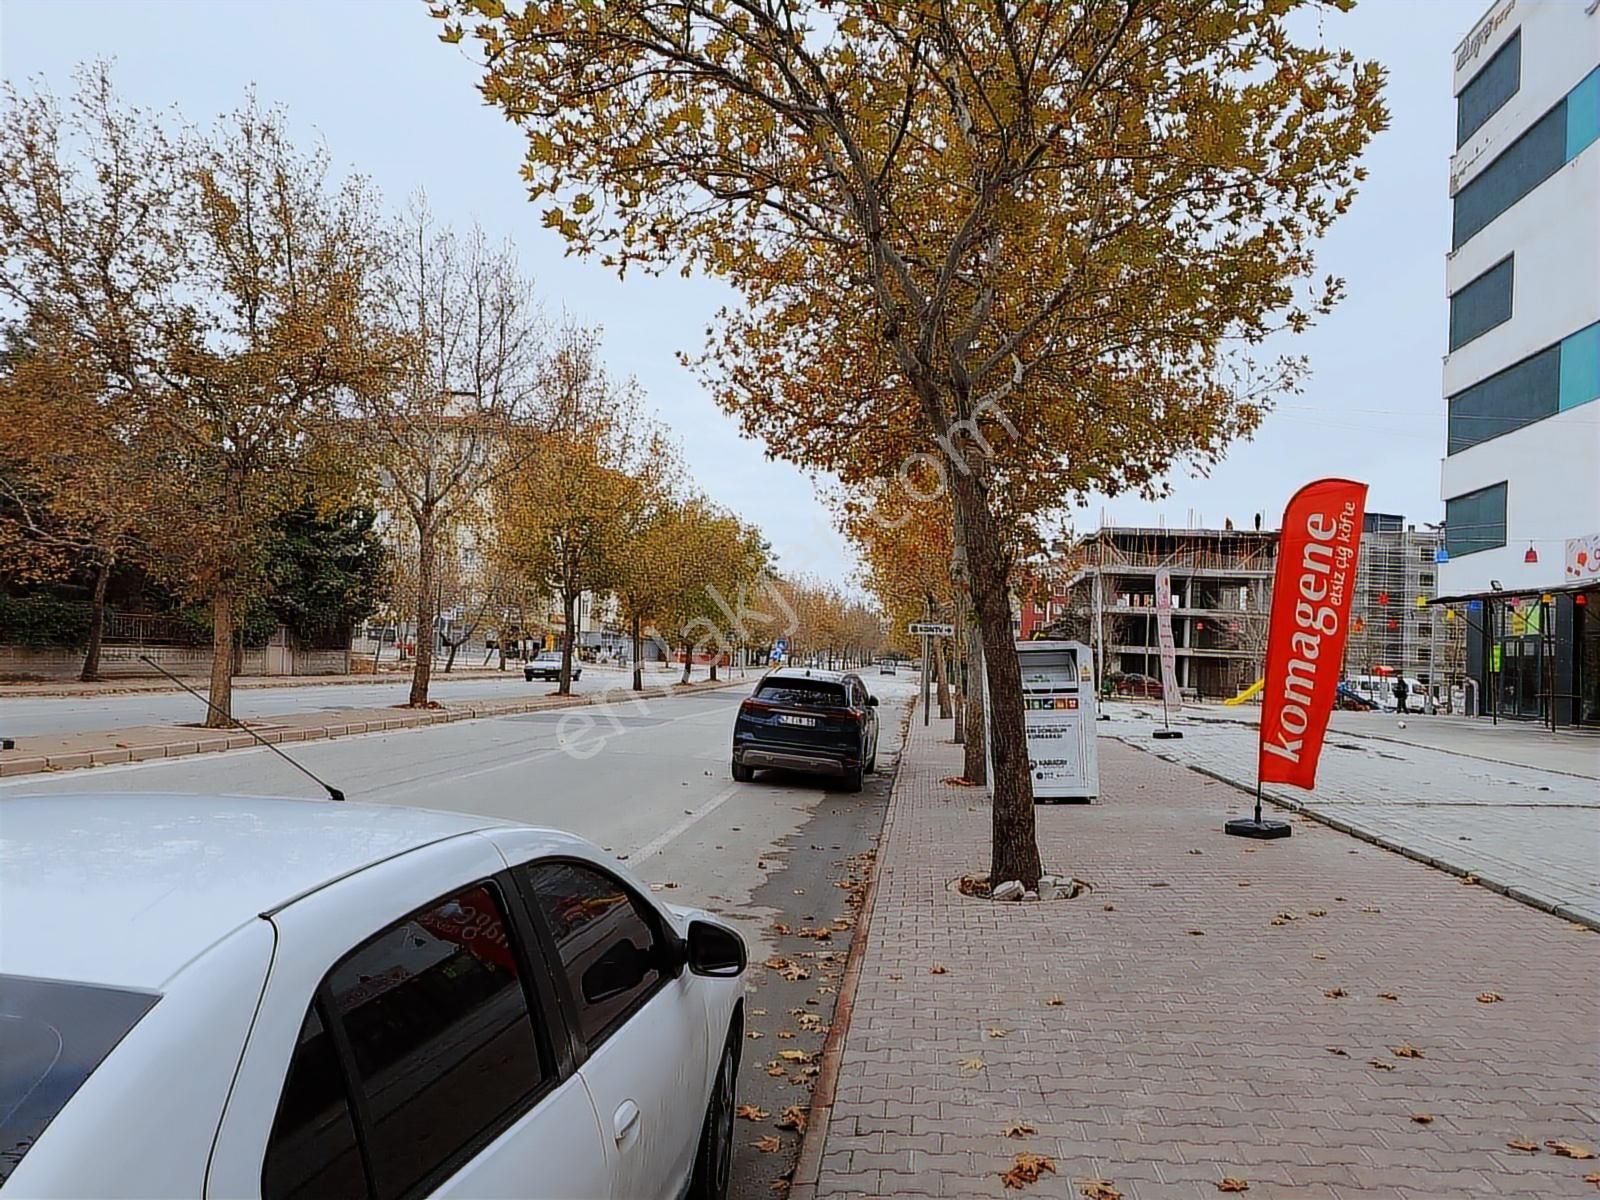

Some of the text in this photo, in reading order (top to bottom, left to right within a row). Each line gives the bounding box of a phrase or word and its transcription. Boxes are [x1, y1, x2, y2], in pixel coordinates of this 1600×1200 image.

[1336, 501, 1356, 543] köfte
[1329, 571, 1346, 606] etsiz
[1263, 512, 1338, 763] komagene
